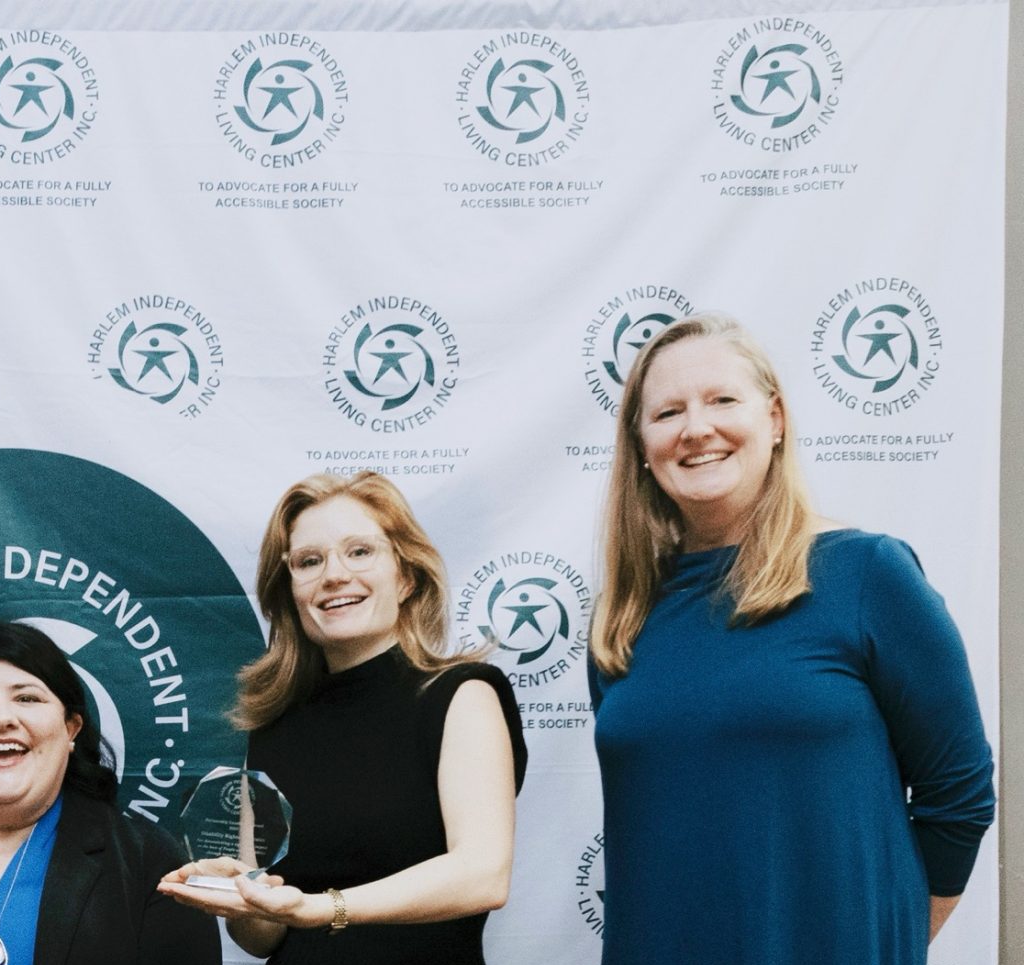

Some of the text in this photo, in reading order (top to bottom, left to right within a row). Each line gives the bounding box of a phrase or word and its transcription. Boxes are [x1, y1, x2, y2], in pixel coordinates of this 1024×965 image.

[11, 29, 99, 100] INDEPENDENT
[214, 32, 348, 102] HARLEM INDEPENDENT
[456, 32, 589, 102] HARLEM INDEPENDENT
[711, 18, 843, 90] HARLEM INDEPENDENT
[11, 139, 76, 165] CENTER
[216, 112, 256, 161] LIVING
[261, 140, 325, 168] CENTER
[458, 115, 500, 161] LIVING
[505, 141, 569, 167] CENTER
[714, 103, 756, 145] LIVING
[761, 124, 820, 152] CENTER
[36, 180, 61, 190] FOR
[63, 181, 73, 190] A
[76, 181, 111, 190] FULLY
[46, 196, 97, 208] SOCIETY
[88, 295, 223, 366] HARLEM INDEPENDENT
[323, 296, 459, 366] HARLEM INDEPENDENT
[581, 285, 693, 357] HARLEM INDEPEN
[811, 278, 942, 351] HARLEM INDEPENDENT
[325, 378, 366, 426] LIVING
[371, 406, 436, 433] CENTER
[813, 364, 858, 409] LIVING
[863, 389, 920, 416] CENTER
[456, 560, 499, 622] HARLEM
[528, 703, 564, 713] FOR A
[538, 718, 587, 729] SOCIETY
[121, 757, 185, 824] NC.
